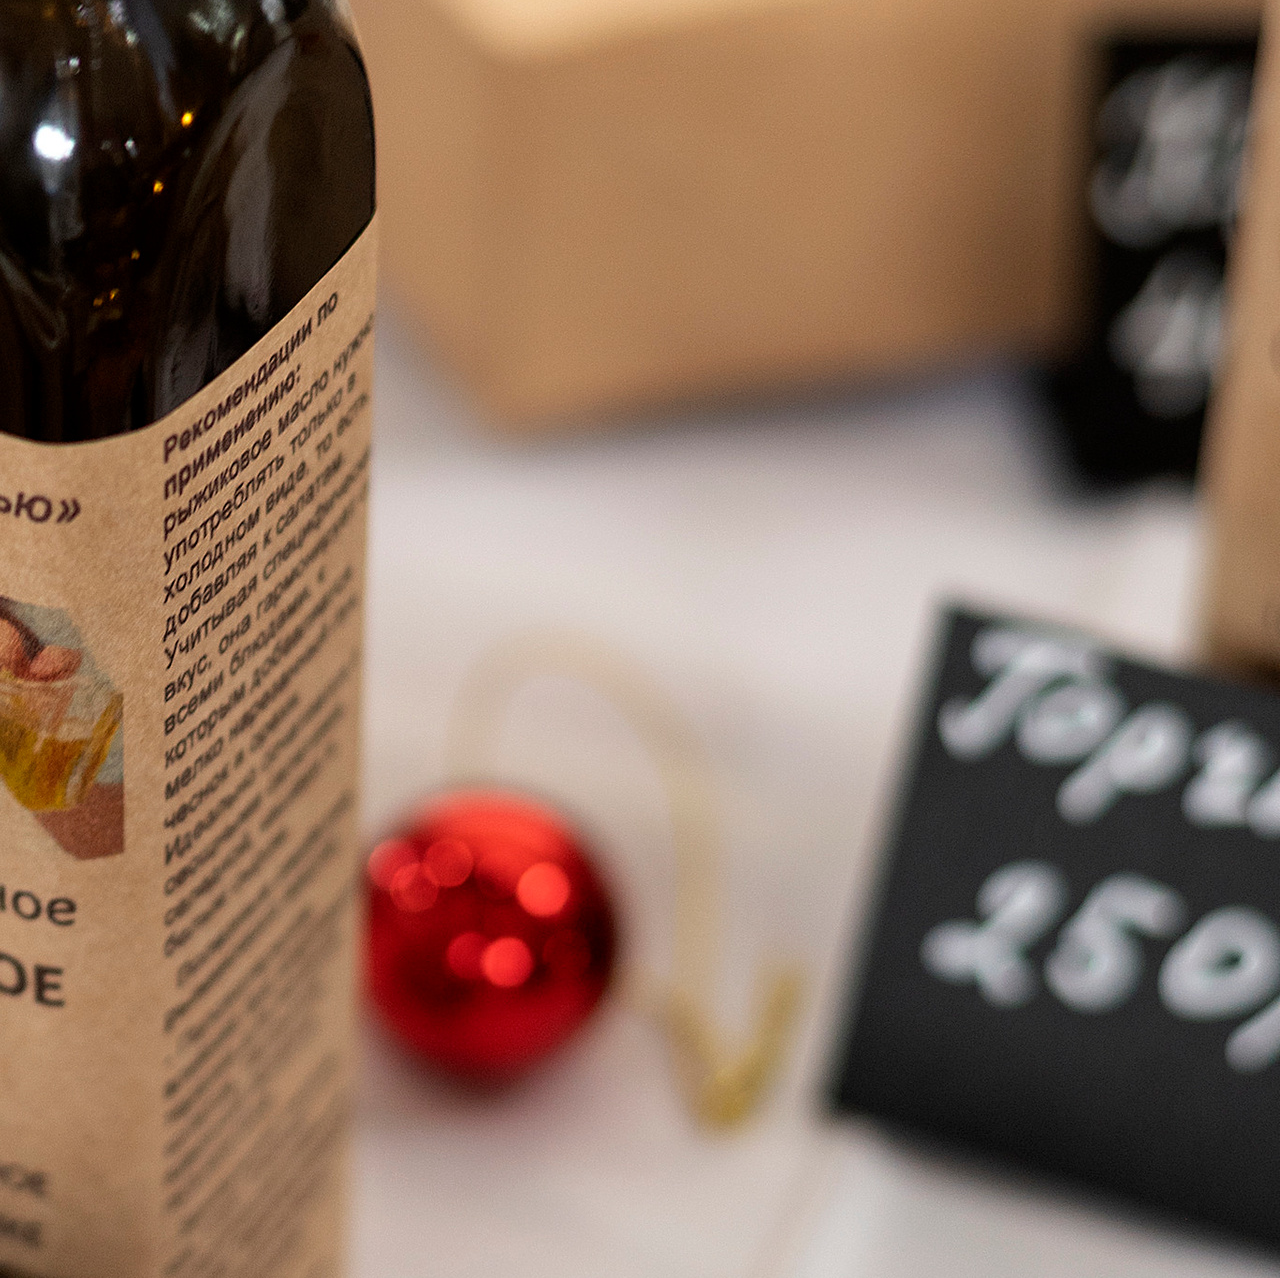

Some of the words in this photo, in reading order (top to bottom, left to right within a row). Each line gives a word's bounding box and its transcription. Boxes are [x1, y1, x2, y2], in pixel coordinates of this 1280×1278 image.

[163, 317, 313, 463] Рекомендации
[317, 292, 338, 327] по
[164, 364, 301, 500] применению:
[164, 428, 271, 542] рыжиковое
[277, 370, 328, 437] масло
[164, 455, 284, 575] употреблять
[289, 388, 343, 455] только
[346, 372, 357, 394] в
[163, 506, 260, 605] холодном
[316, 432, 333, 462] то
[163, 542, 258, 643] добавляя
[263, 528, 272, 550] к
[163, 574, 258, 670] Учитывая
[164, 654, 212, 704] вкус,
[218, 614, 252, 655] она
[164, 671, 224, 737] всеми
[164, 682, 247, 769] которым
[164, 736, 224, 800] мелко
